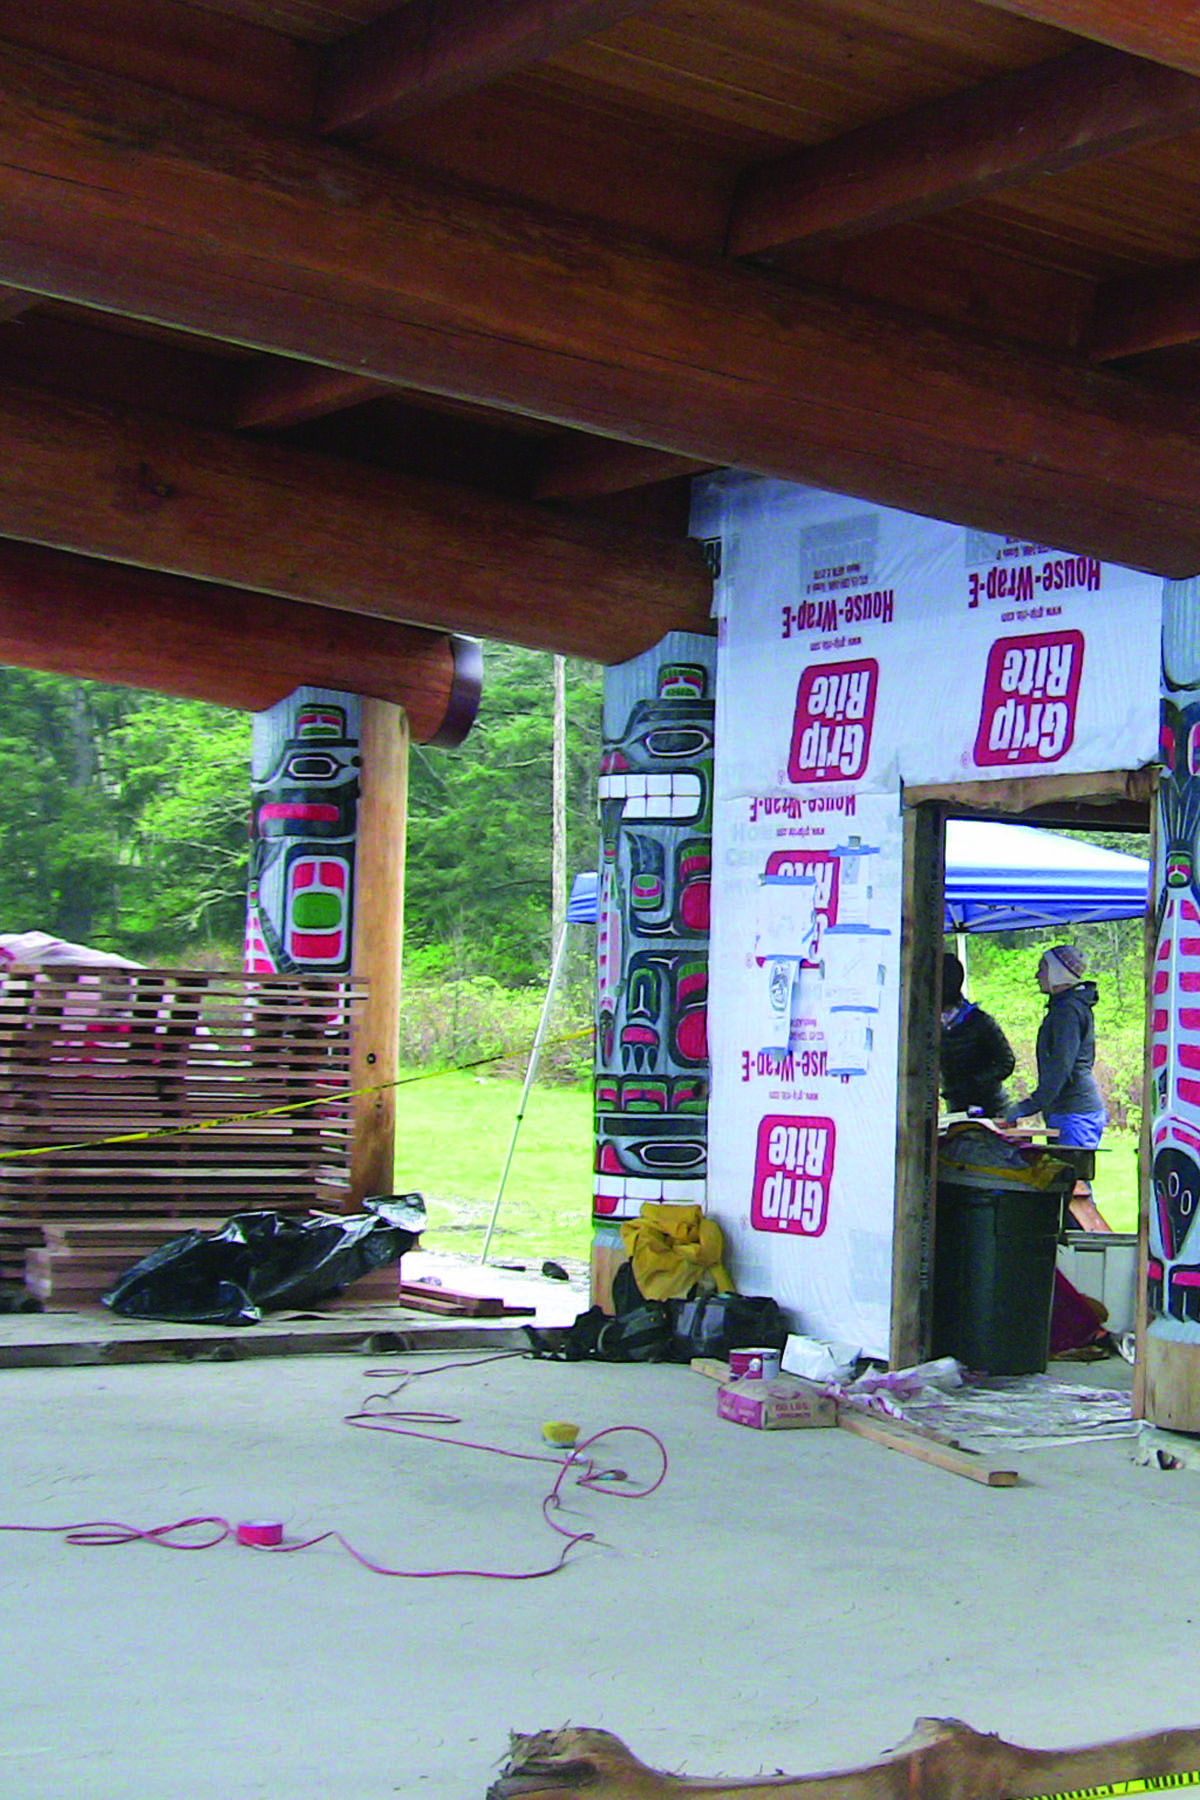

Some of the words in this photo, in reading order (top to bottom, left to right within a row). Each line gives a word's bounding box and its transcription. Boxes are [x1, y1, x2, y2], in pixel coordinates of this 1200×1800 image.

[968, 556, 1102, 609] House-Wrap-E
[782, 589, 894, 639] House-Wrap-E
[807, 670, 871, 719] Rite
[1001, 643, 1073, 697] Rite
[800, 719, 866, 778] Grip
[988, 698, 1068, 762] Grip
[767, 1124, 828, 1176] Rite
[761, 1171, 825, 1233] Grip
